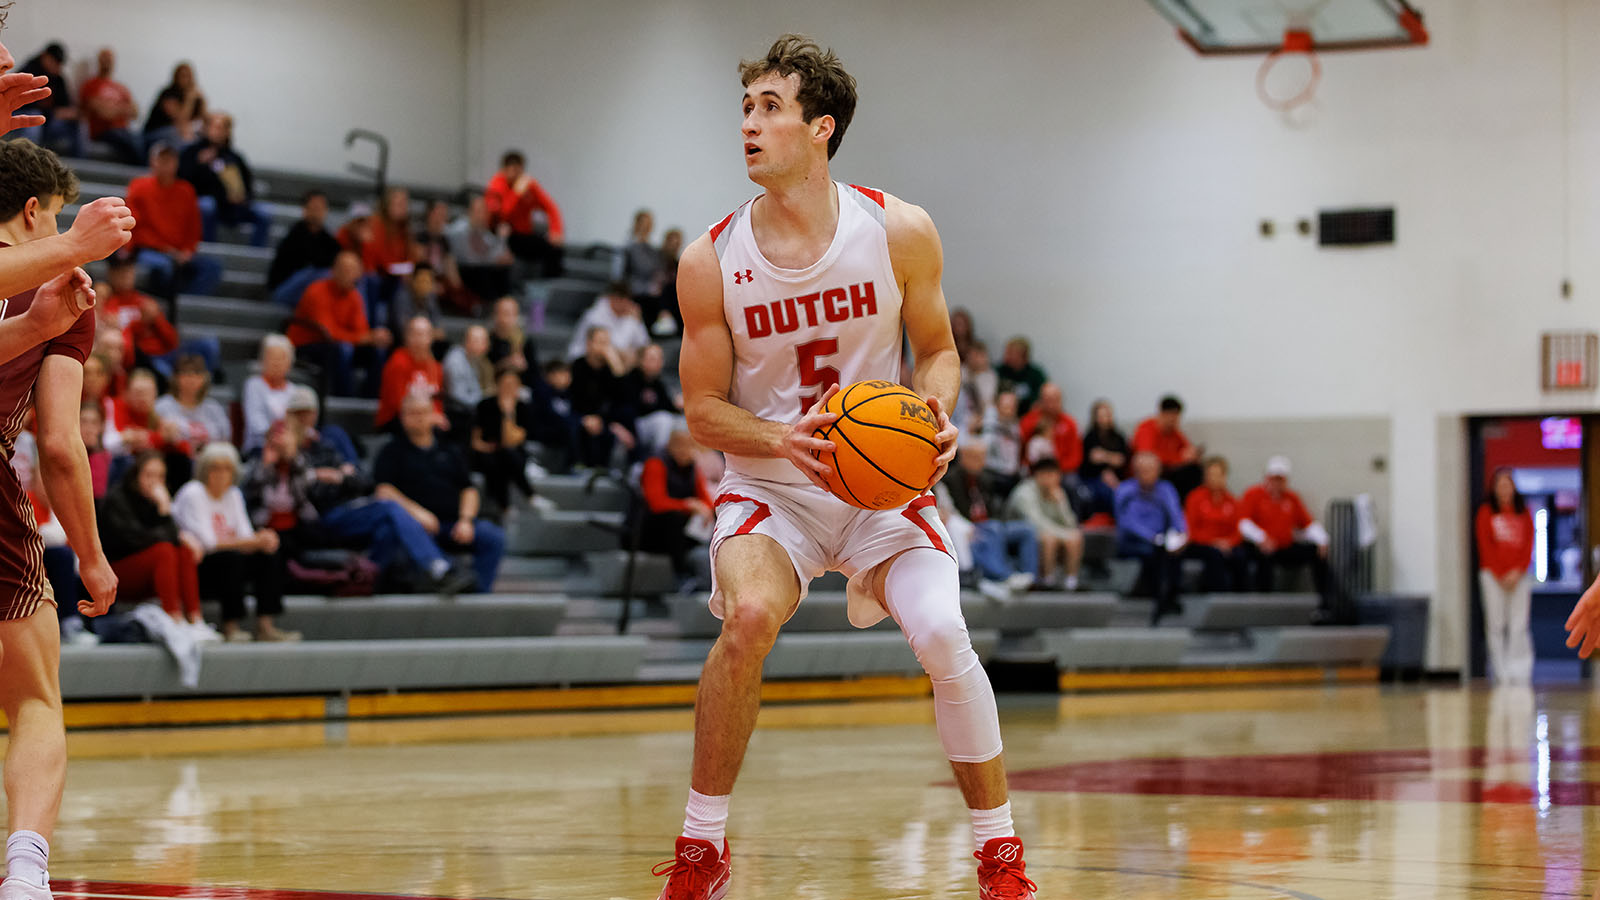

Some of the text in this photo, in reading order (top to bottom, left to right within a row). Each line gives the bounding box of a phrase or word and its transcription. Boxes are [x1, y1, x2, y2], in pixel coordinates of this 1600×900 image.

[743, 280, 878, 339] DUTCH
[794, 336, 841, 417] 5
[900, 400, 939, 429] NCA
